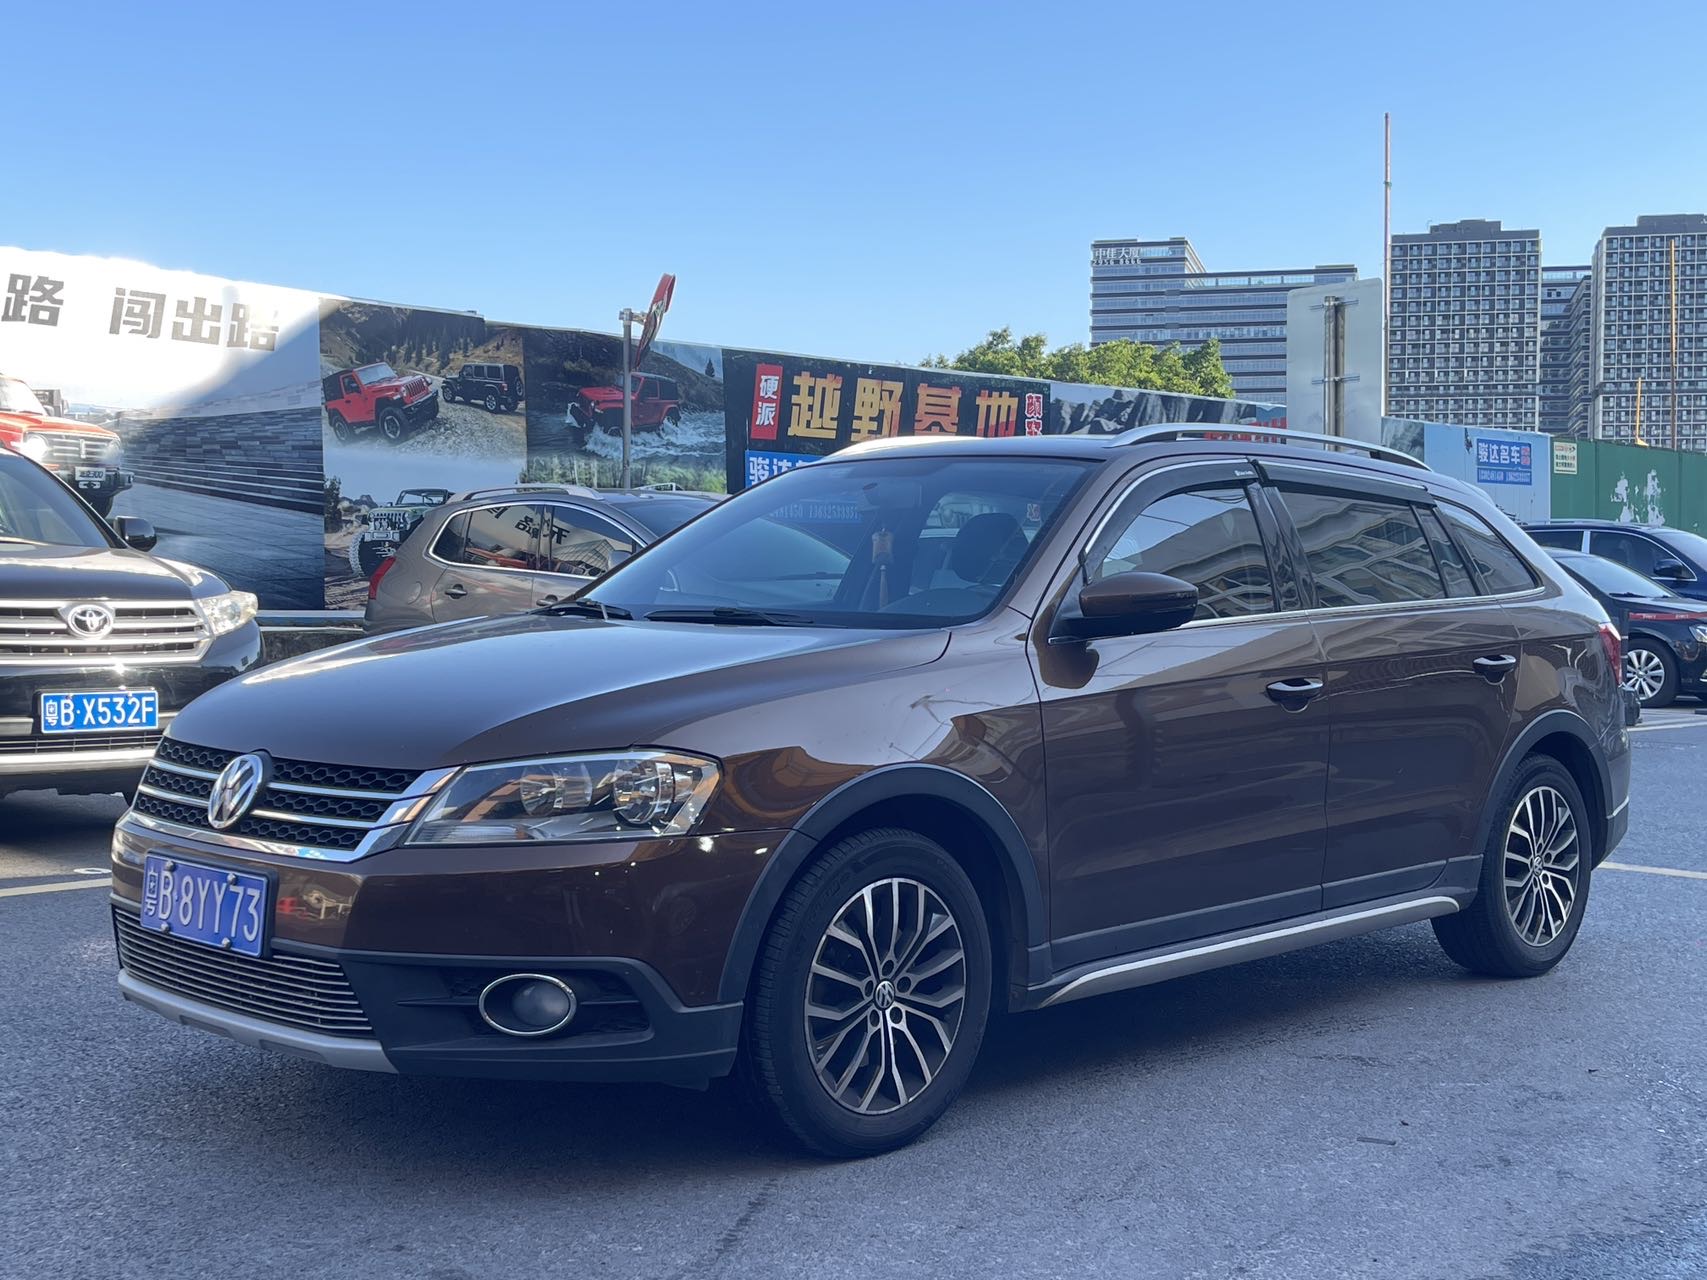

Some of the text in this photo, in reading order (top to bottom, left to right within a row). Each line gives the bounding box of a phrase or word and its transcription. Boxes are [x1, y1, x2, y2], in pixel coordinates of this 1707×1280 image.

[1095, 247, 1140, 259] 中佳大厦
[1, 274, 279, 351] 路 闯出路
[755, 375, 779, 426] 硬派
[787, 372, 1018, 440] 越野基地
[1479, 443, 1521, 464] 骏达名车
[45, 696, 155, 727] 粤B·X532F
[144, 865, 261, 943] 粤B·8YY73
